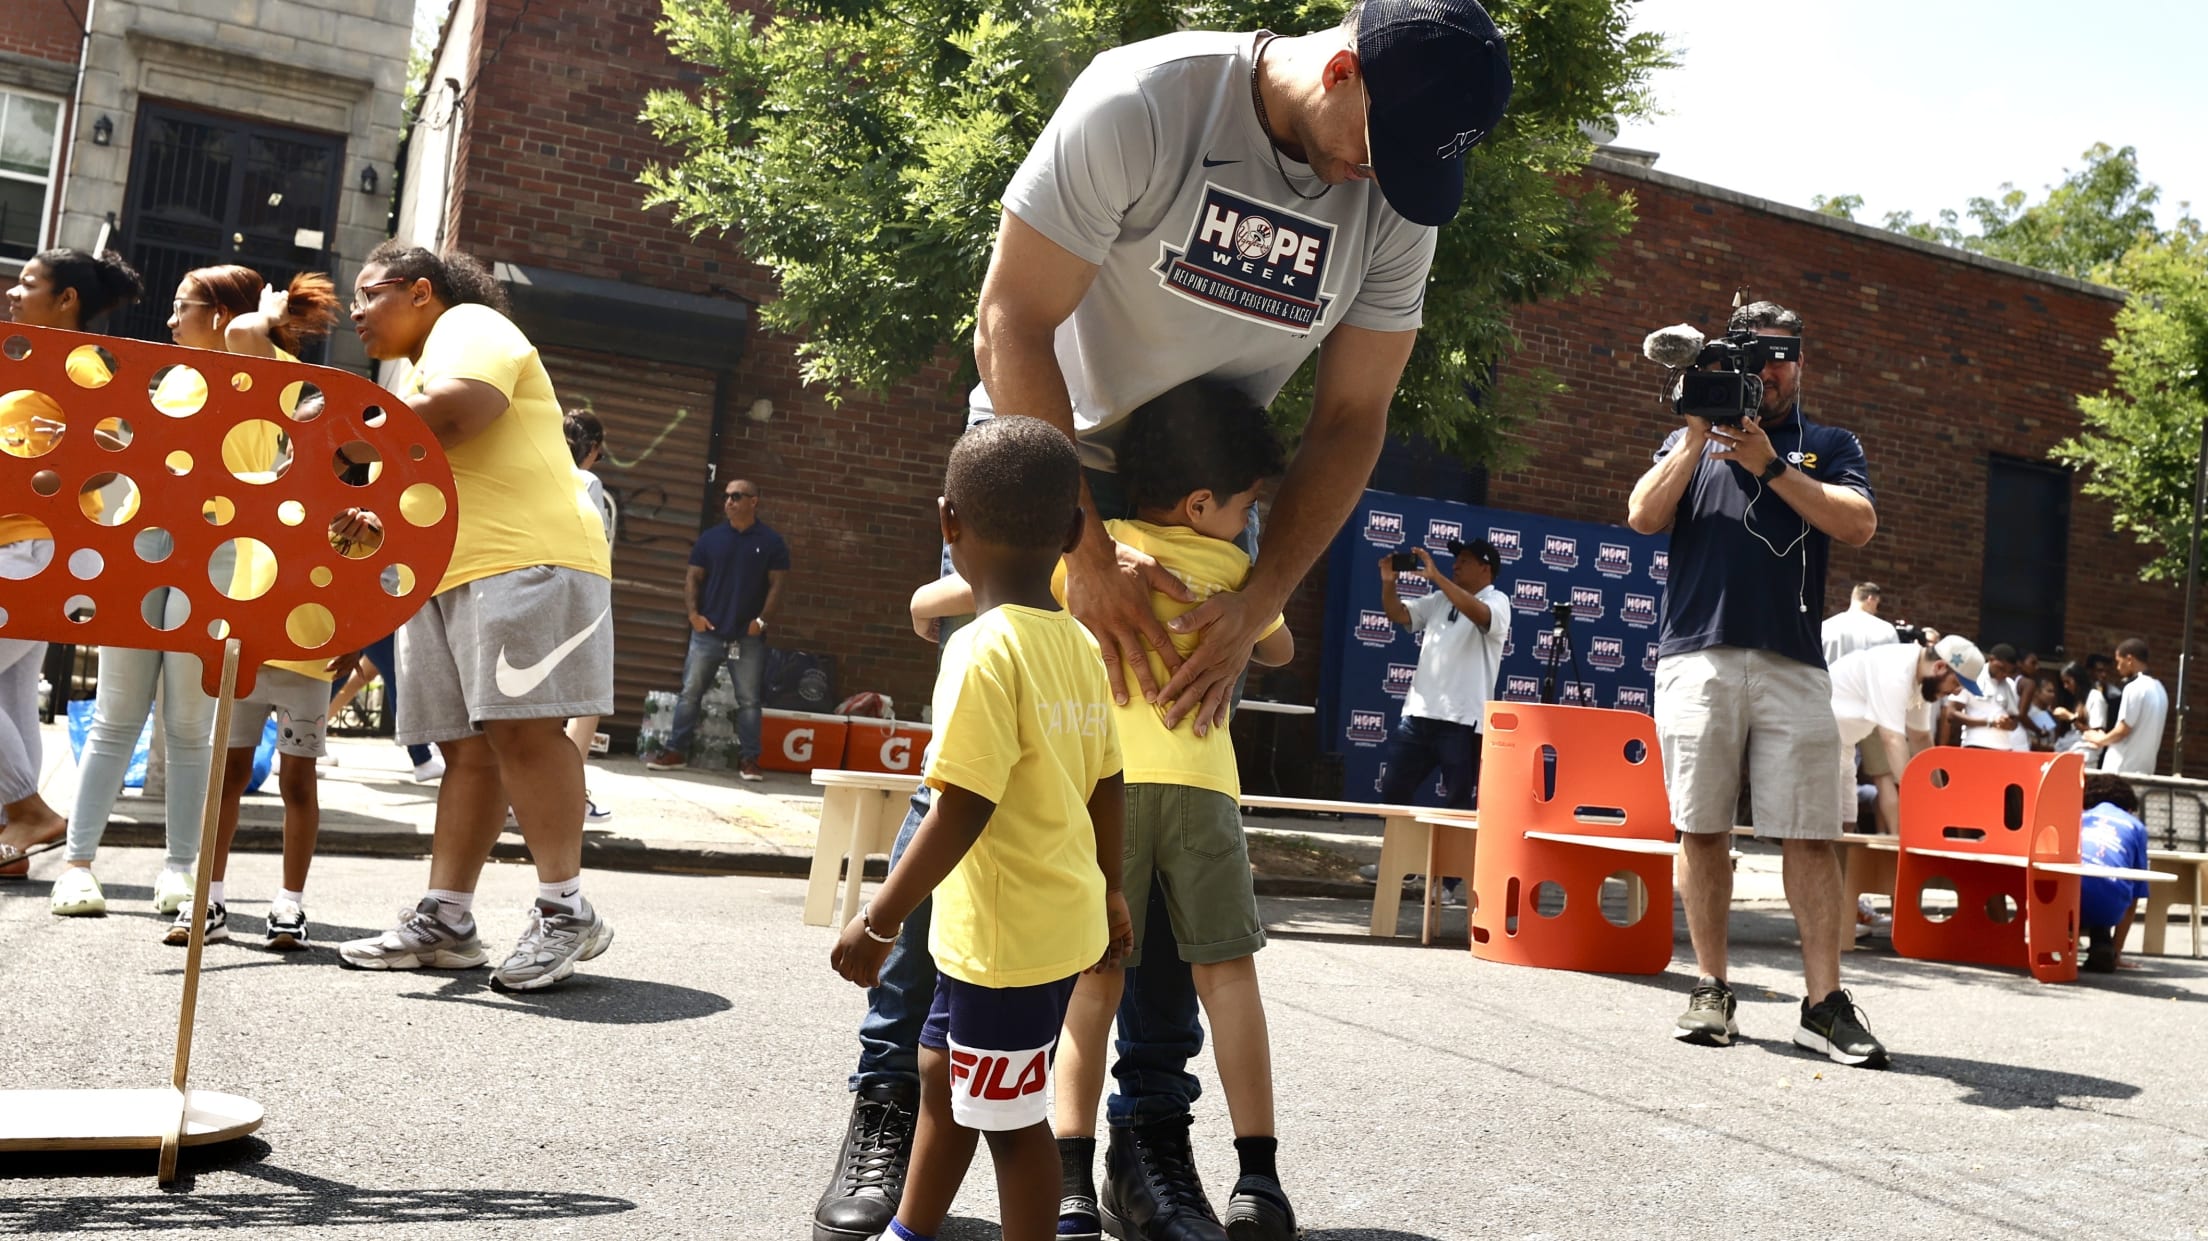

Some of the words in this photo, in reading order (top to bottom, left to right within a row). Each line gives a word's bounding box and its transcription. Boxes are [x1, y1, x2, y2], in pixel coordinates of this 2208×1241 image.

[1200, 204, 1321, 275] HOPE
[1212, 251, 1296, 287] WEEK
[1173, 267, 1209, 292] HELPING
[1209, 281, 1239, 302] OTHERS
[1239, 291, 1281, 315] PERSEVERE
[1290, 306, 1312, 323] EXCEL
[1371, 515, 1400, 529] HOPE
[1432, 523, 1459, 537] HOPE
[1490, 531, 1517, 545] HOPE
[1547, 539, 1574, 553] HOPE
[1601, 547, 1627, 560] HOPE
[1517, 583, 1544, 597] HOPE
[1573, 591, 1600, 604] HOPE
[1627, 597, 1652, 610] HOPE
[1362, 615, 1390, 628] HOPE
[1594, 641, 1620, 653] HOPE
[1509, 679, 1536, 692] HOPE
[1620, 690, 1645, 703] HOPE
[1353, 714, 1382, 727] HOPE
[783, 728, 815, 762] G
[880, 737, 912, 770] G
[950, 1050, 1047, 1100] FILA
